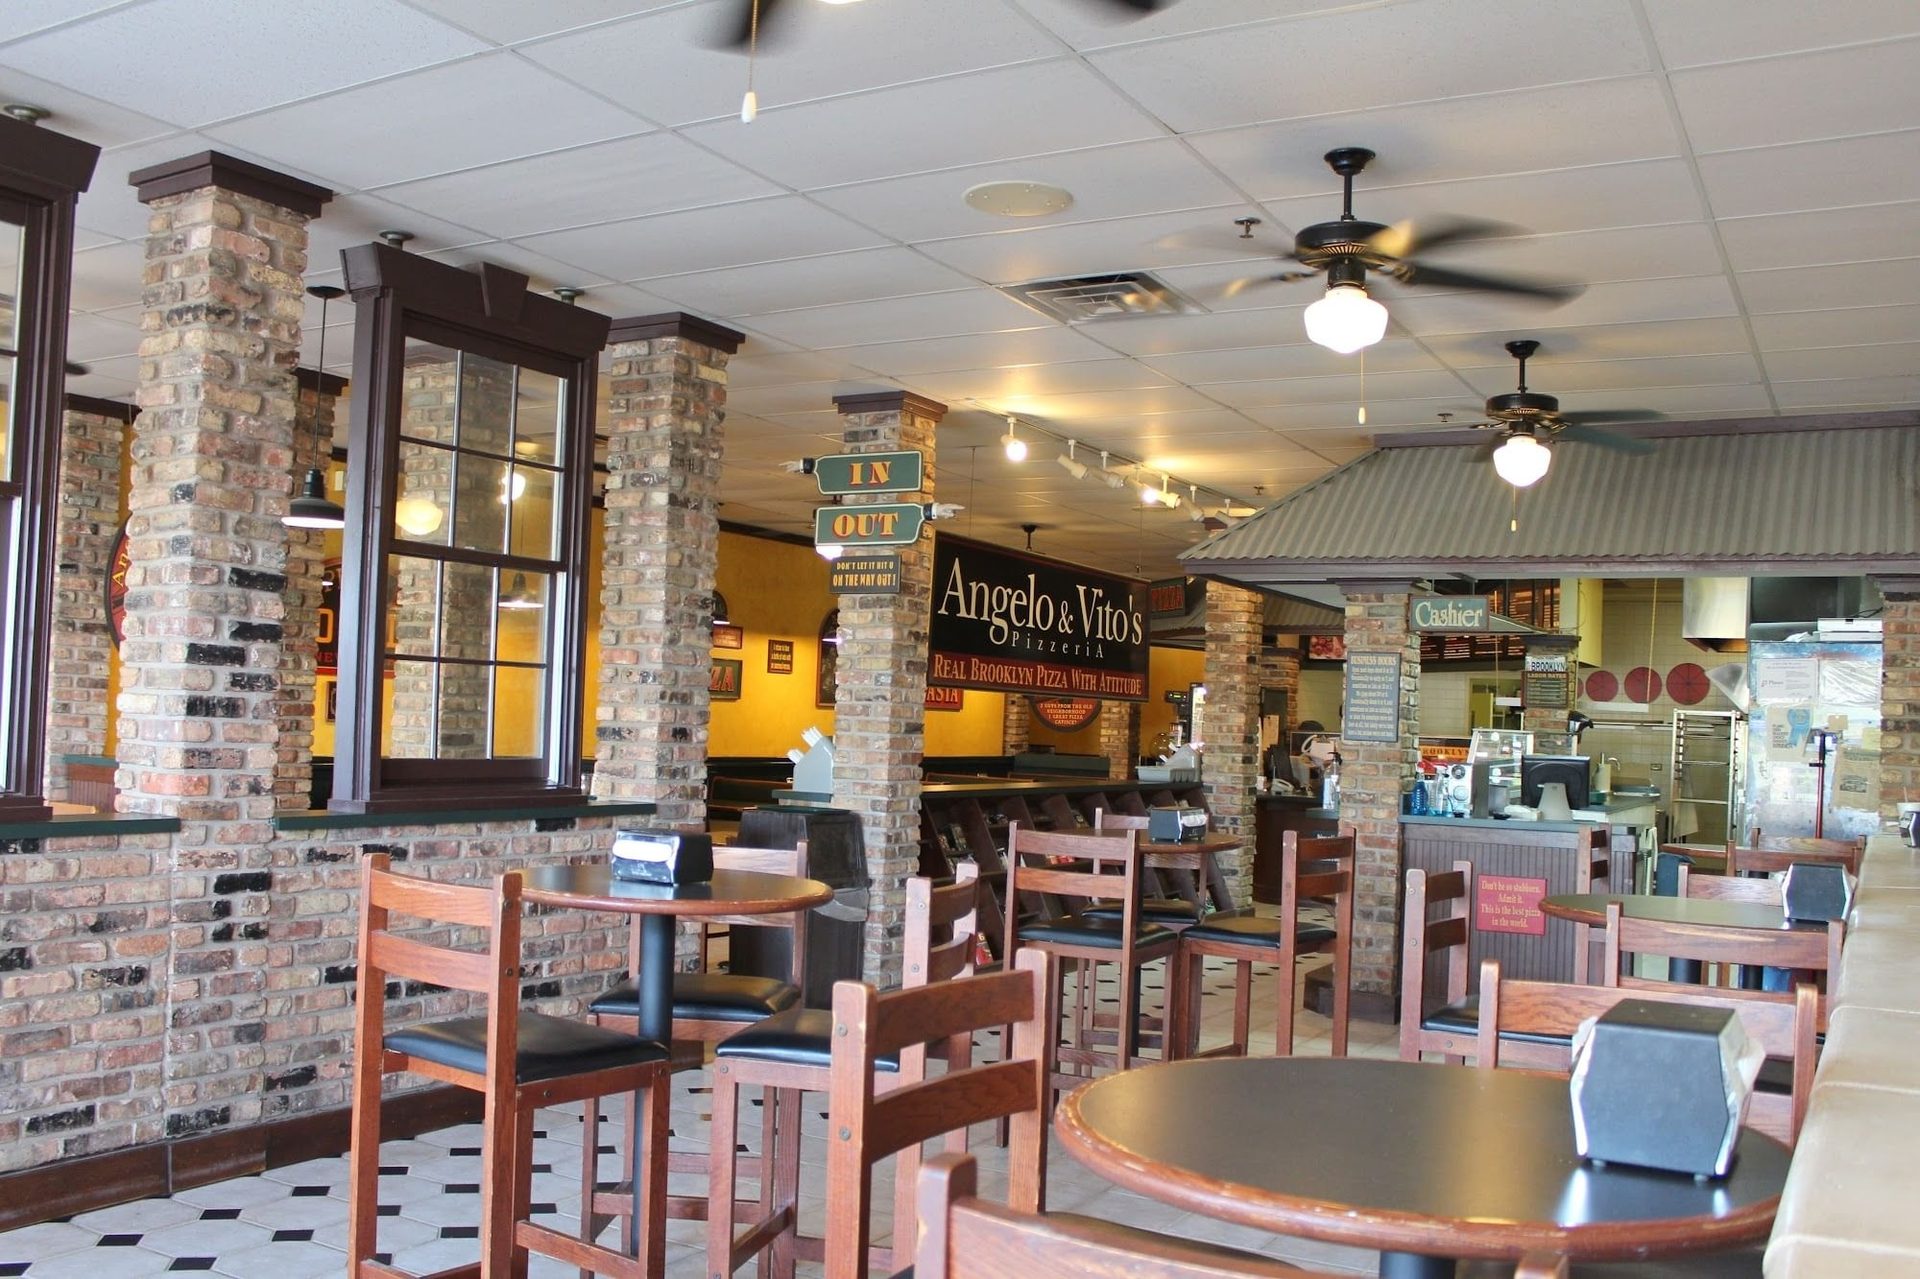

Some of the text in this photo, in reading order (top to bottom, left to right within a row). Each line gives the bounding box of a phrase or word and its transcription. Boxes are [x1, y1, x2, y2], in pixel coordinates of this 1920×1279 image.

[849, 462, 891, 486] IN
[833, 512, 898, 538] OUT
[836, 561, 894, 570] DON'T LET IT HIT U
[833, 575, 844, 587] ON
[845, 574, 859, 587] THE
[860, 574, 875, 587] WAY
[937, 557, 1143, 645] Angelo & Vito's
[1415, 601, 1483, 627] Cashier
[925, 687, 958, 702] ASTA
